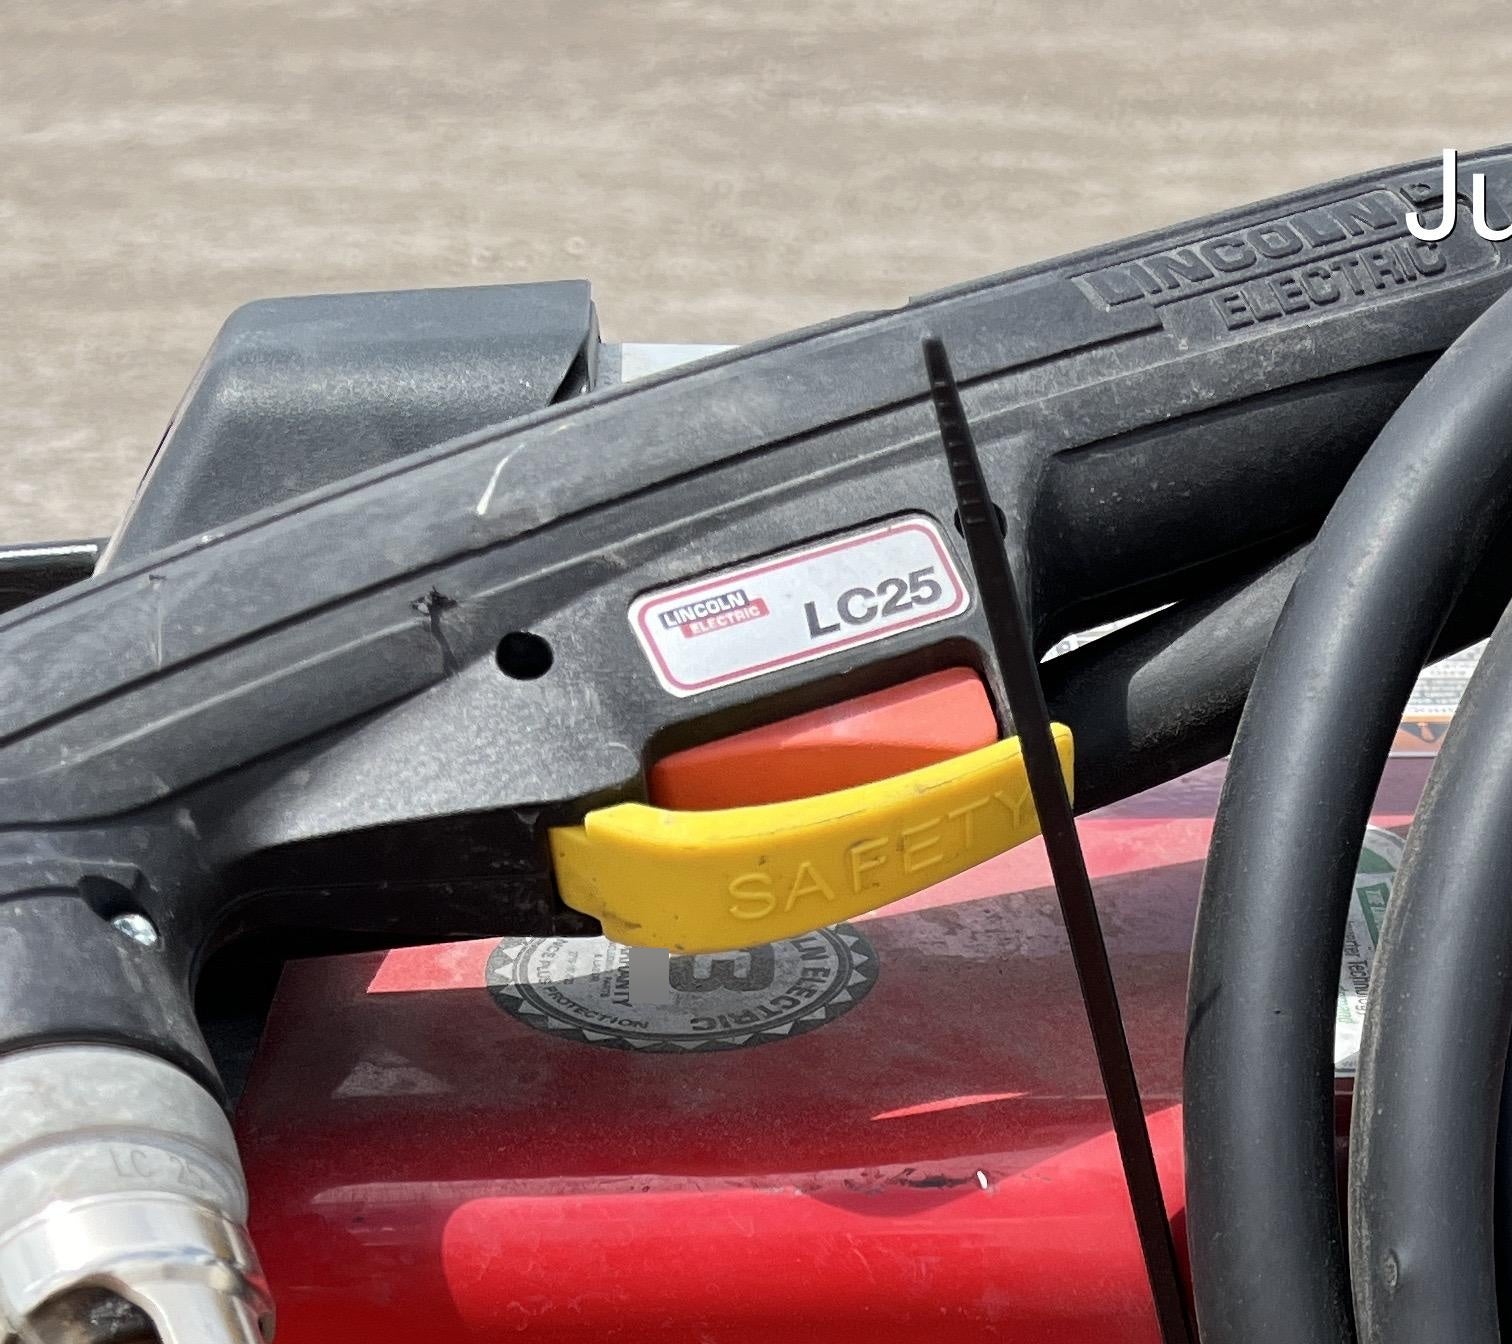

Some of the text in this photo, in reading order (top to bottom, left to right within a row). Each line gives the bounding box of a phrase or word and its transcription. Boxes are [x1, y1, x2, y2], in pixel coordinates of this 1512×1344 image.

[1088, 200, 1397, 306] LINCOLN
[1212, 242, 1447, 331] ELECTRIC
[663, 590, 746, 627] LINCOLN
[689, 604, 763, 635] ELECTRIC
[804, 566, 943, 640] LC25
[727, 782, 1036, 921] SAFETY
